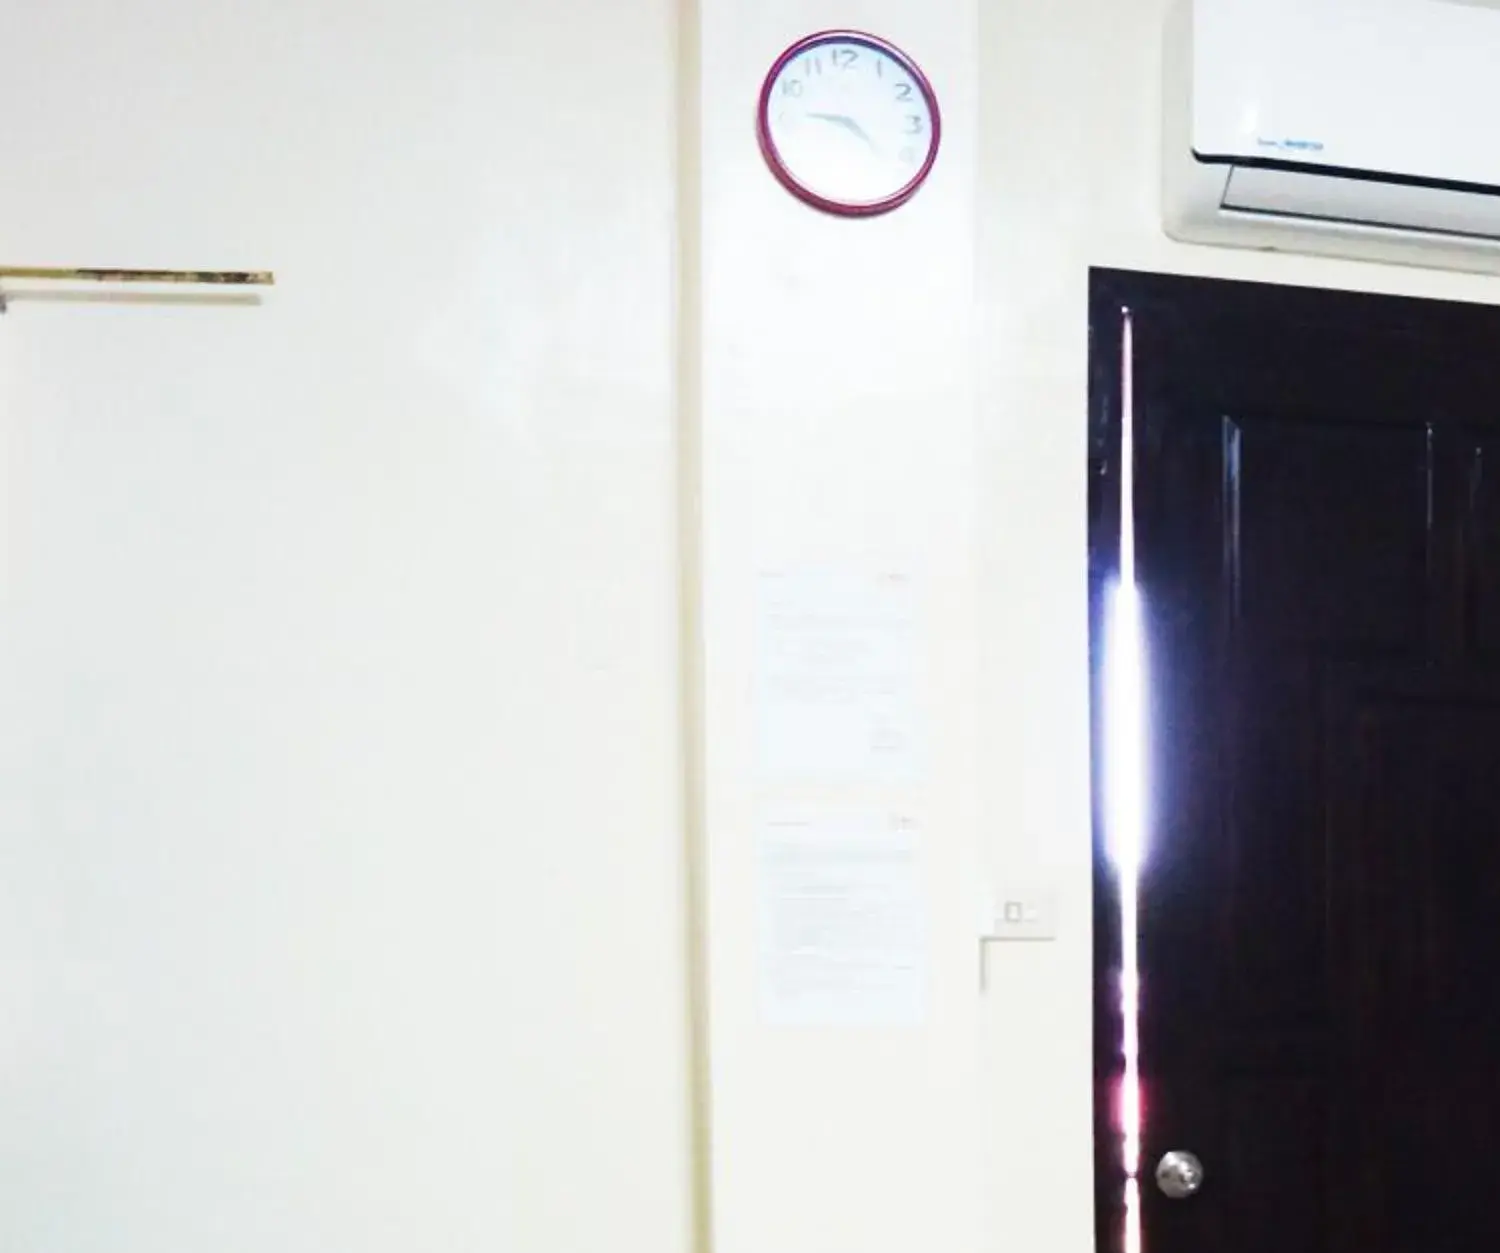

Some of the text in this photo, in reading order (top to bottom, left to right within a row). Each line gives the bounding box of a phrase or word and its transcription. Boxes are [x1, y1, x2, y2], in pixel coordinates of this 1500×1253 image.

[804, 57, 822, 77] 11
[831, 48, 859, 69] 12
[876, 58, 883, 78] 1
[782, 79, 804, 98] 10
[893, 82, 914, 102] 2
[903, 114, 924, 135] 3
